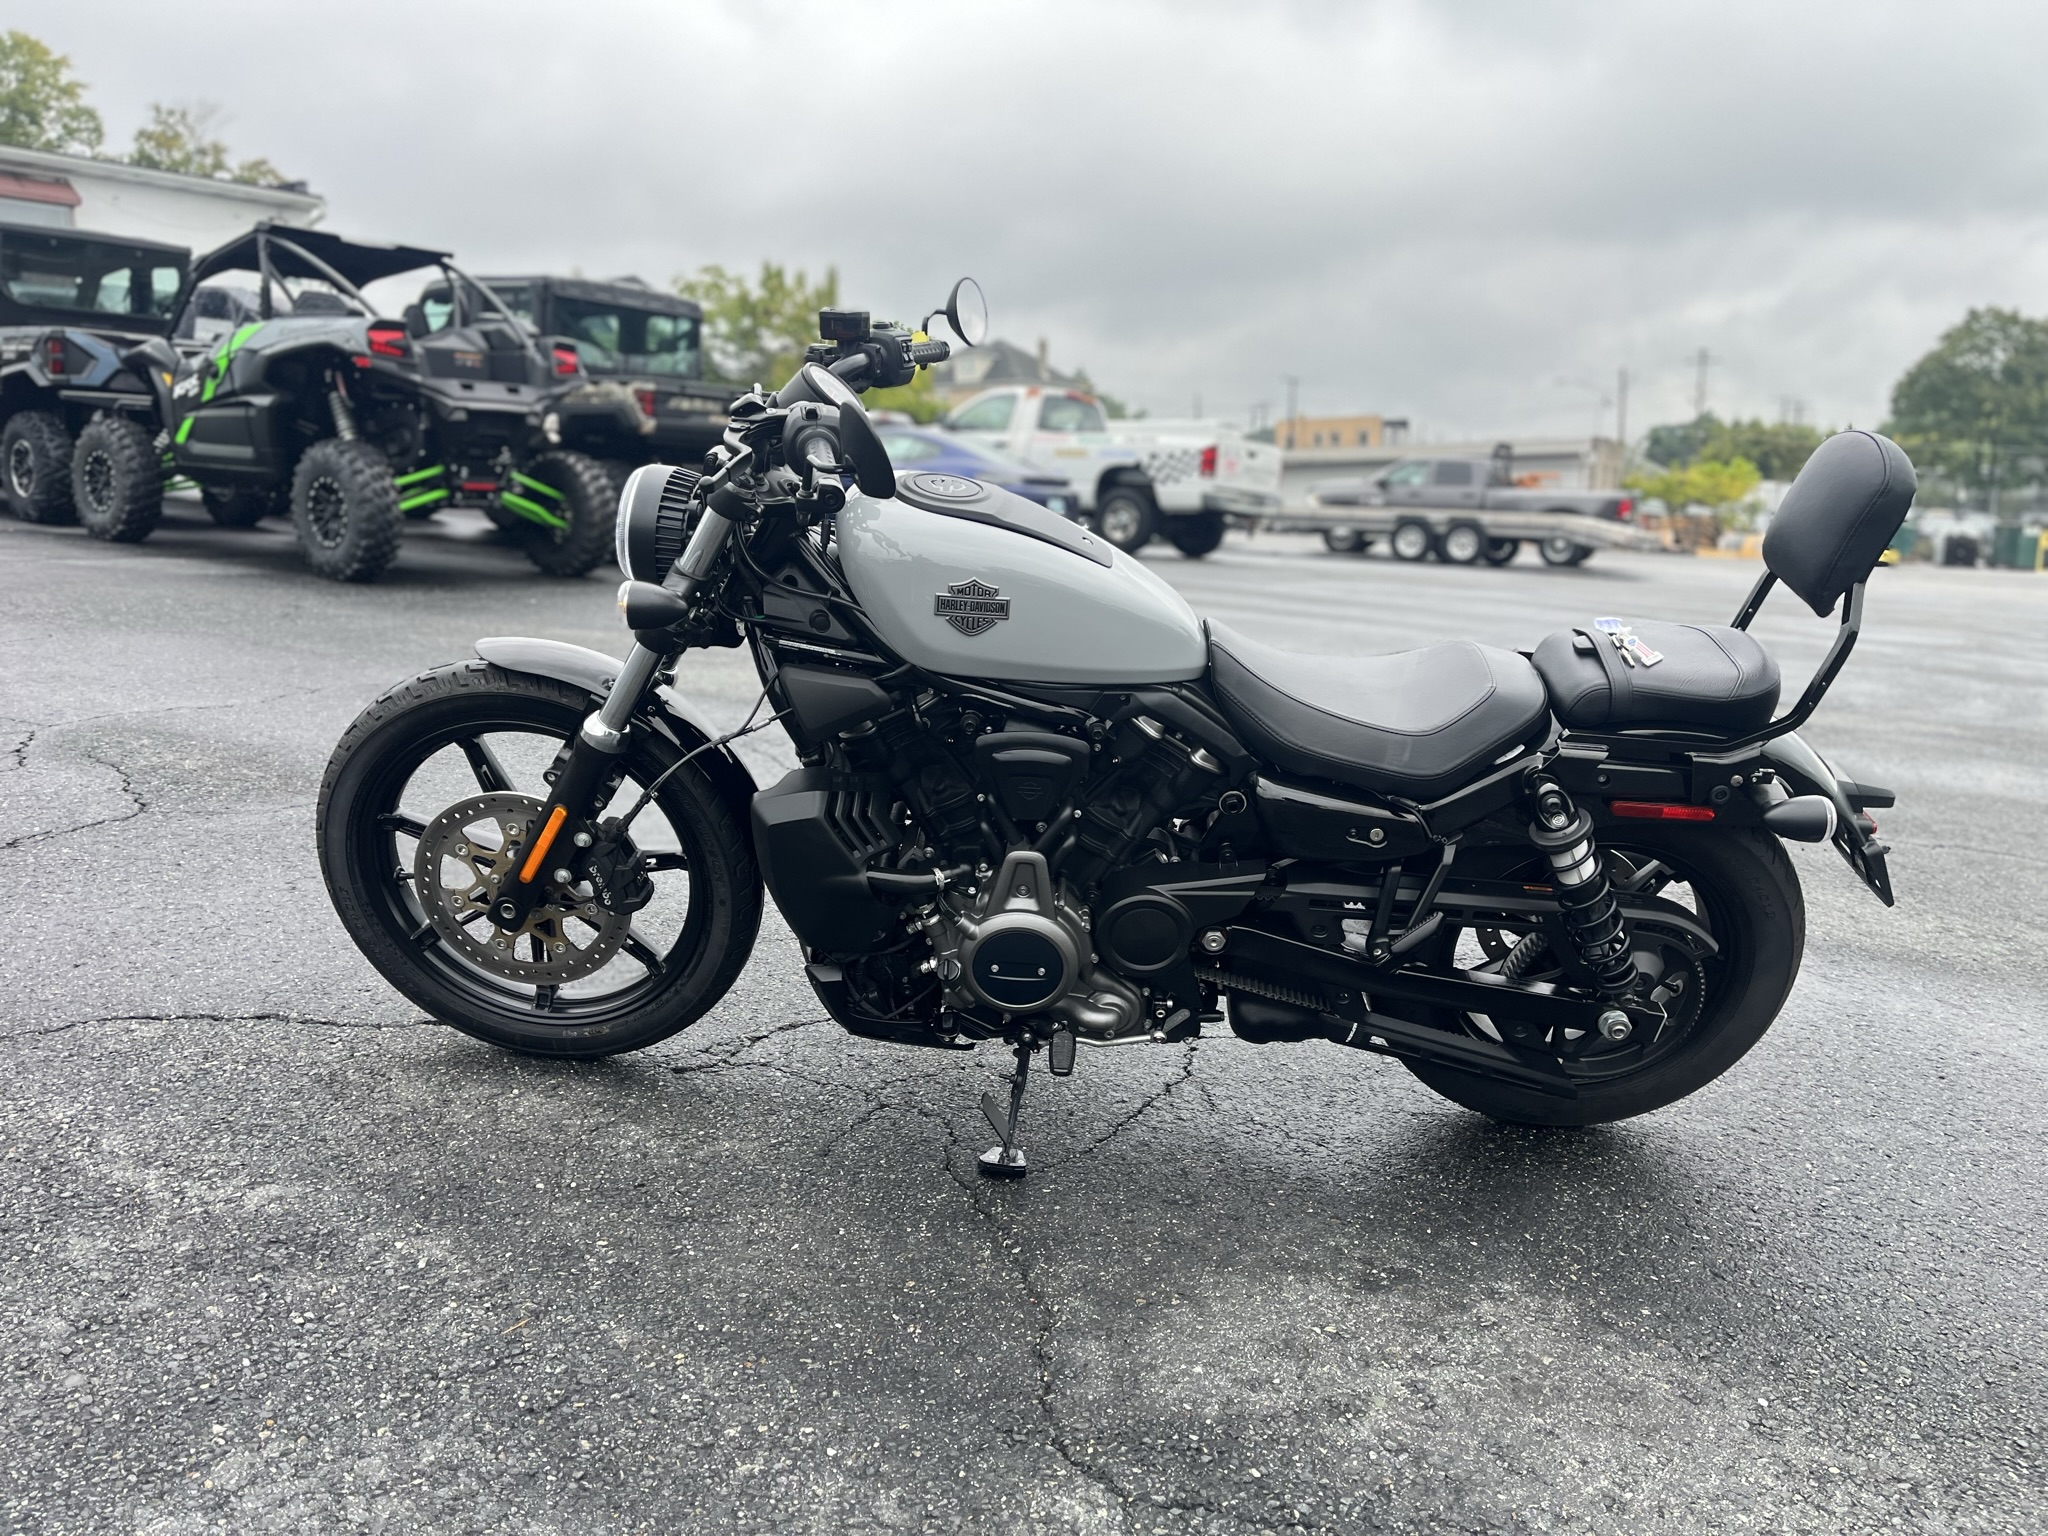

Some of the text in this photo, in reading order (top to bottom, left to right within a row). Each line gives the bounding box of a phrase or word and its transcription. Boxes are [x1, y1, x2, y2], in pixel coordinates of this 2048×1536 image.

[956, 583, 991, 598] MOTOR
[940, 599, 1006, 614] HARLEY-DAVIDSON
[954, 616, 989, 631] CYCLES
